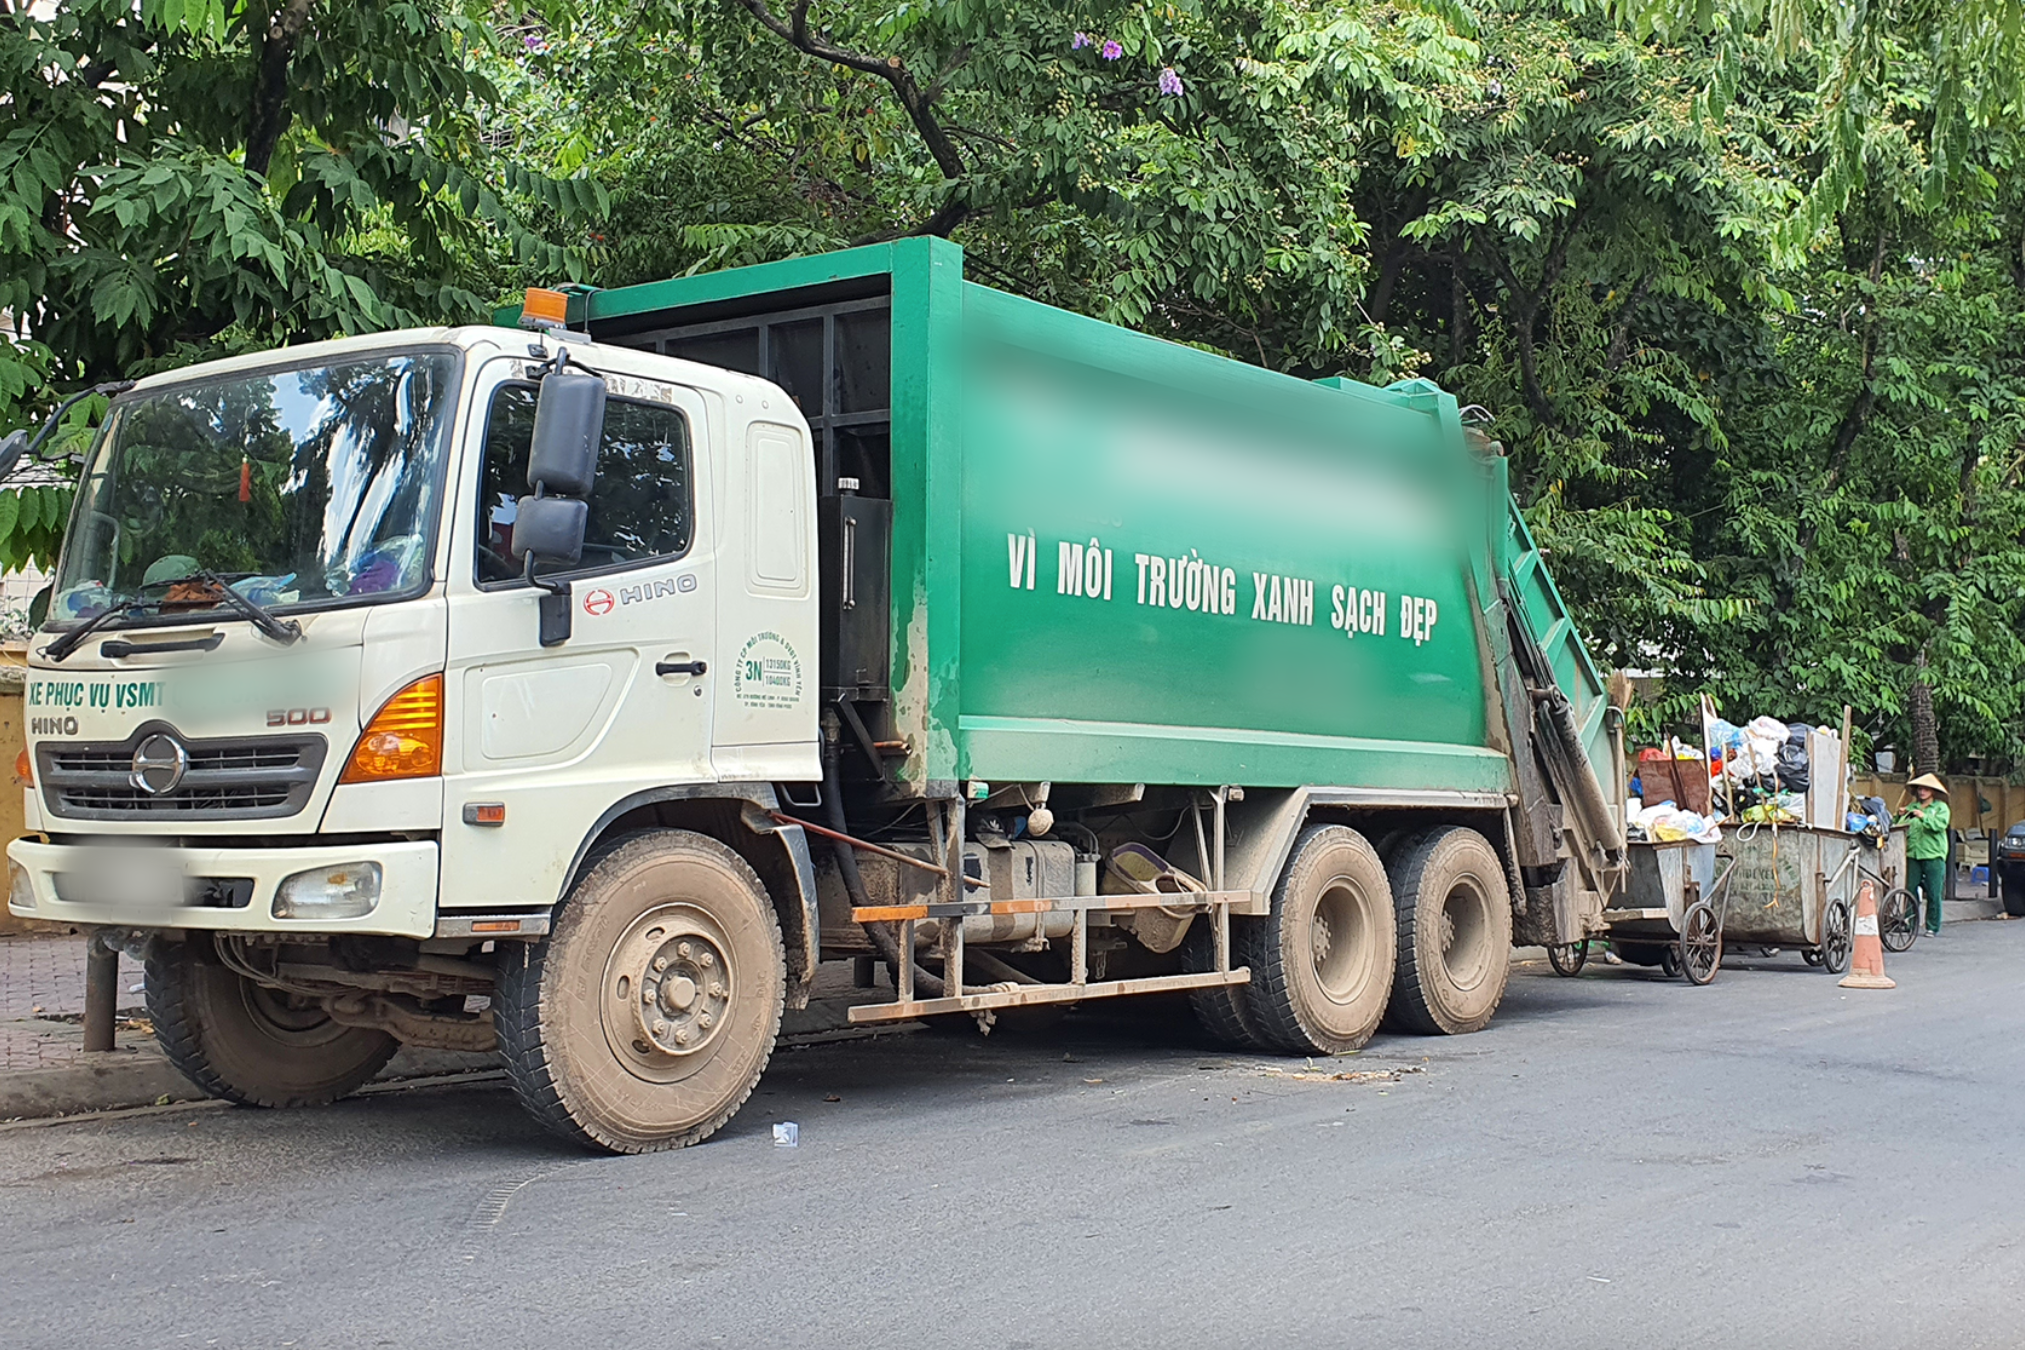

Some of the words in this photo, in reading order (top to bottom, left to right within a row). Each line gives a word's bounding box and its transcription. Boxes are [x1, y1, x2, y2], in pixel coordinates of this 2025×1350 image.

[620, 574, 697, 605] HINO
[1007, 527, 1036, 590] VÌ
[1057, 537, 1112, 600] MÔI
[1135, 548, 1236, 615] TRƯỜNG
[1251, 572, 1314, 626] XANH
[1330, 584, 1386, 639] SẠCH
[1400, 595, 1438, 647] ĐẸP
[746, 660, 762, 681] 3N
[29, 682, 43, 706] XE
[46, 682, 84, 712] PHỤC
[89, 683, 110, 713] VỤ
[31, 716, 79, 736] HINO
[266, 707, 332, 727] 500
